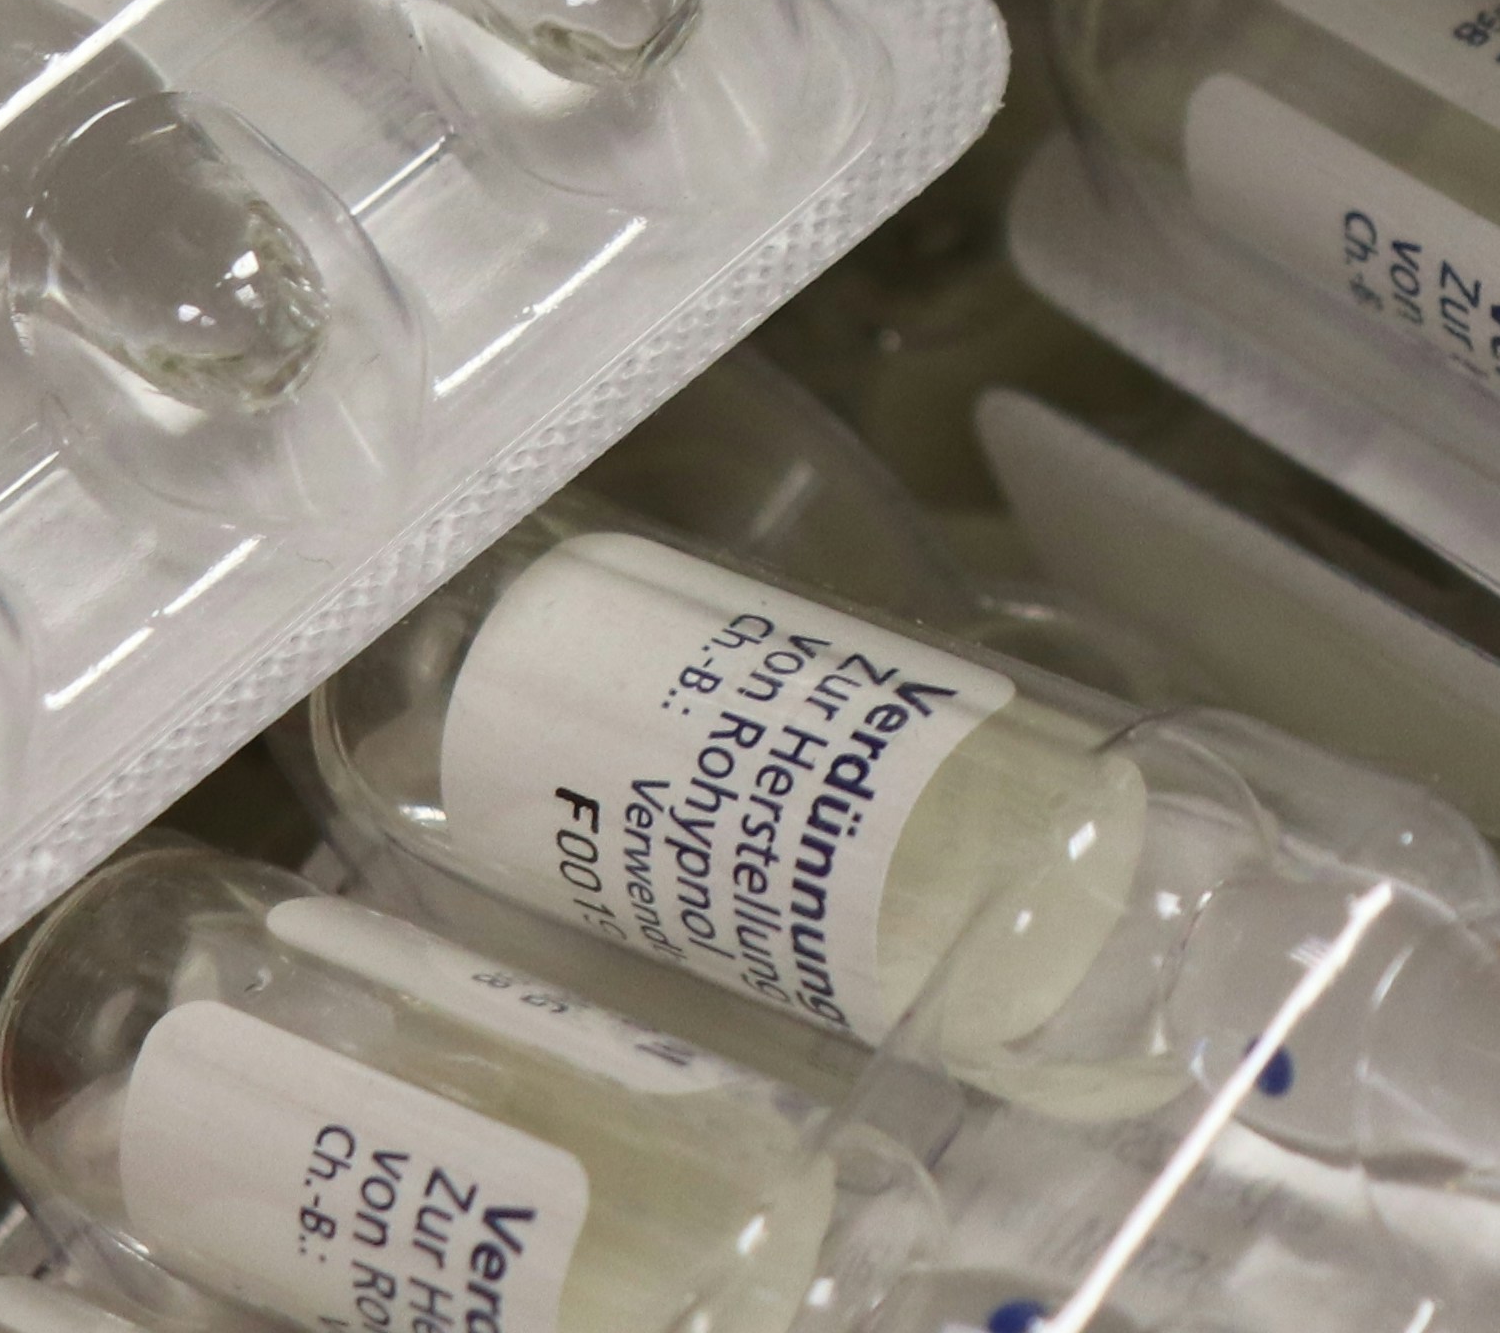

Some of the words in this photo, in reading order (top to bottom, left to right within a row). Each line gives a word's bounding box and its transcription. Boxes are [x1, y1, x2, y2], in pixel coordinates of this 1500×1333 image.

[1388, 237, 1426, 330] von
[1436, 260, 1484, 354] Zur
[735, 631, 833, 704] von
[804, 651, 901, 723] Zur
[662, 708, 769, 963] Rohypnol
[729, 723, 832, 1007] Herstellung
[791, 676, 961, 1032] Verdünnung
[352, 1149, 411, 1249] von
[412, 1166, 479, 1270] Zur
